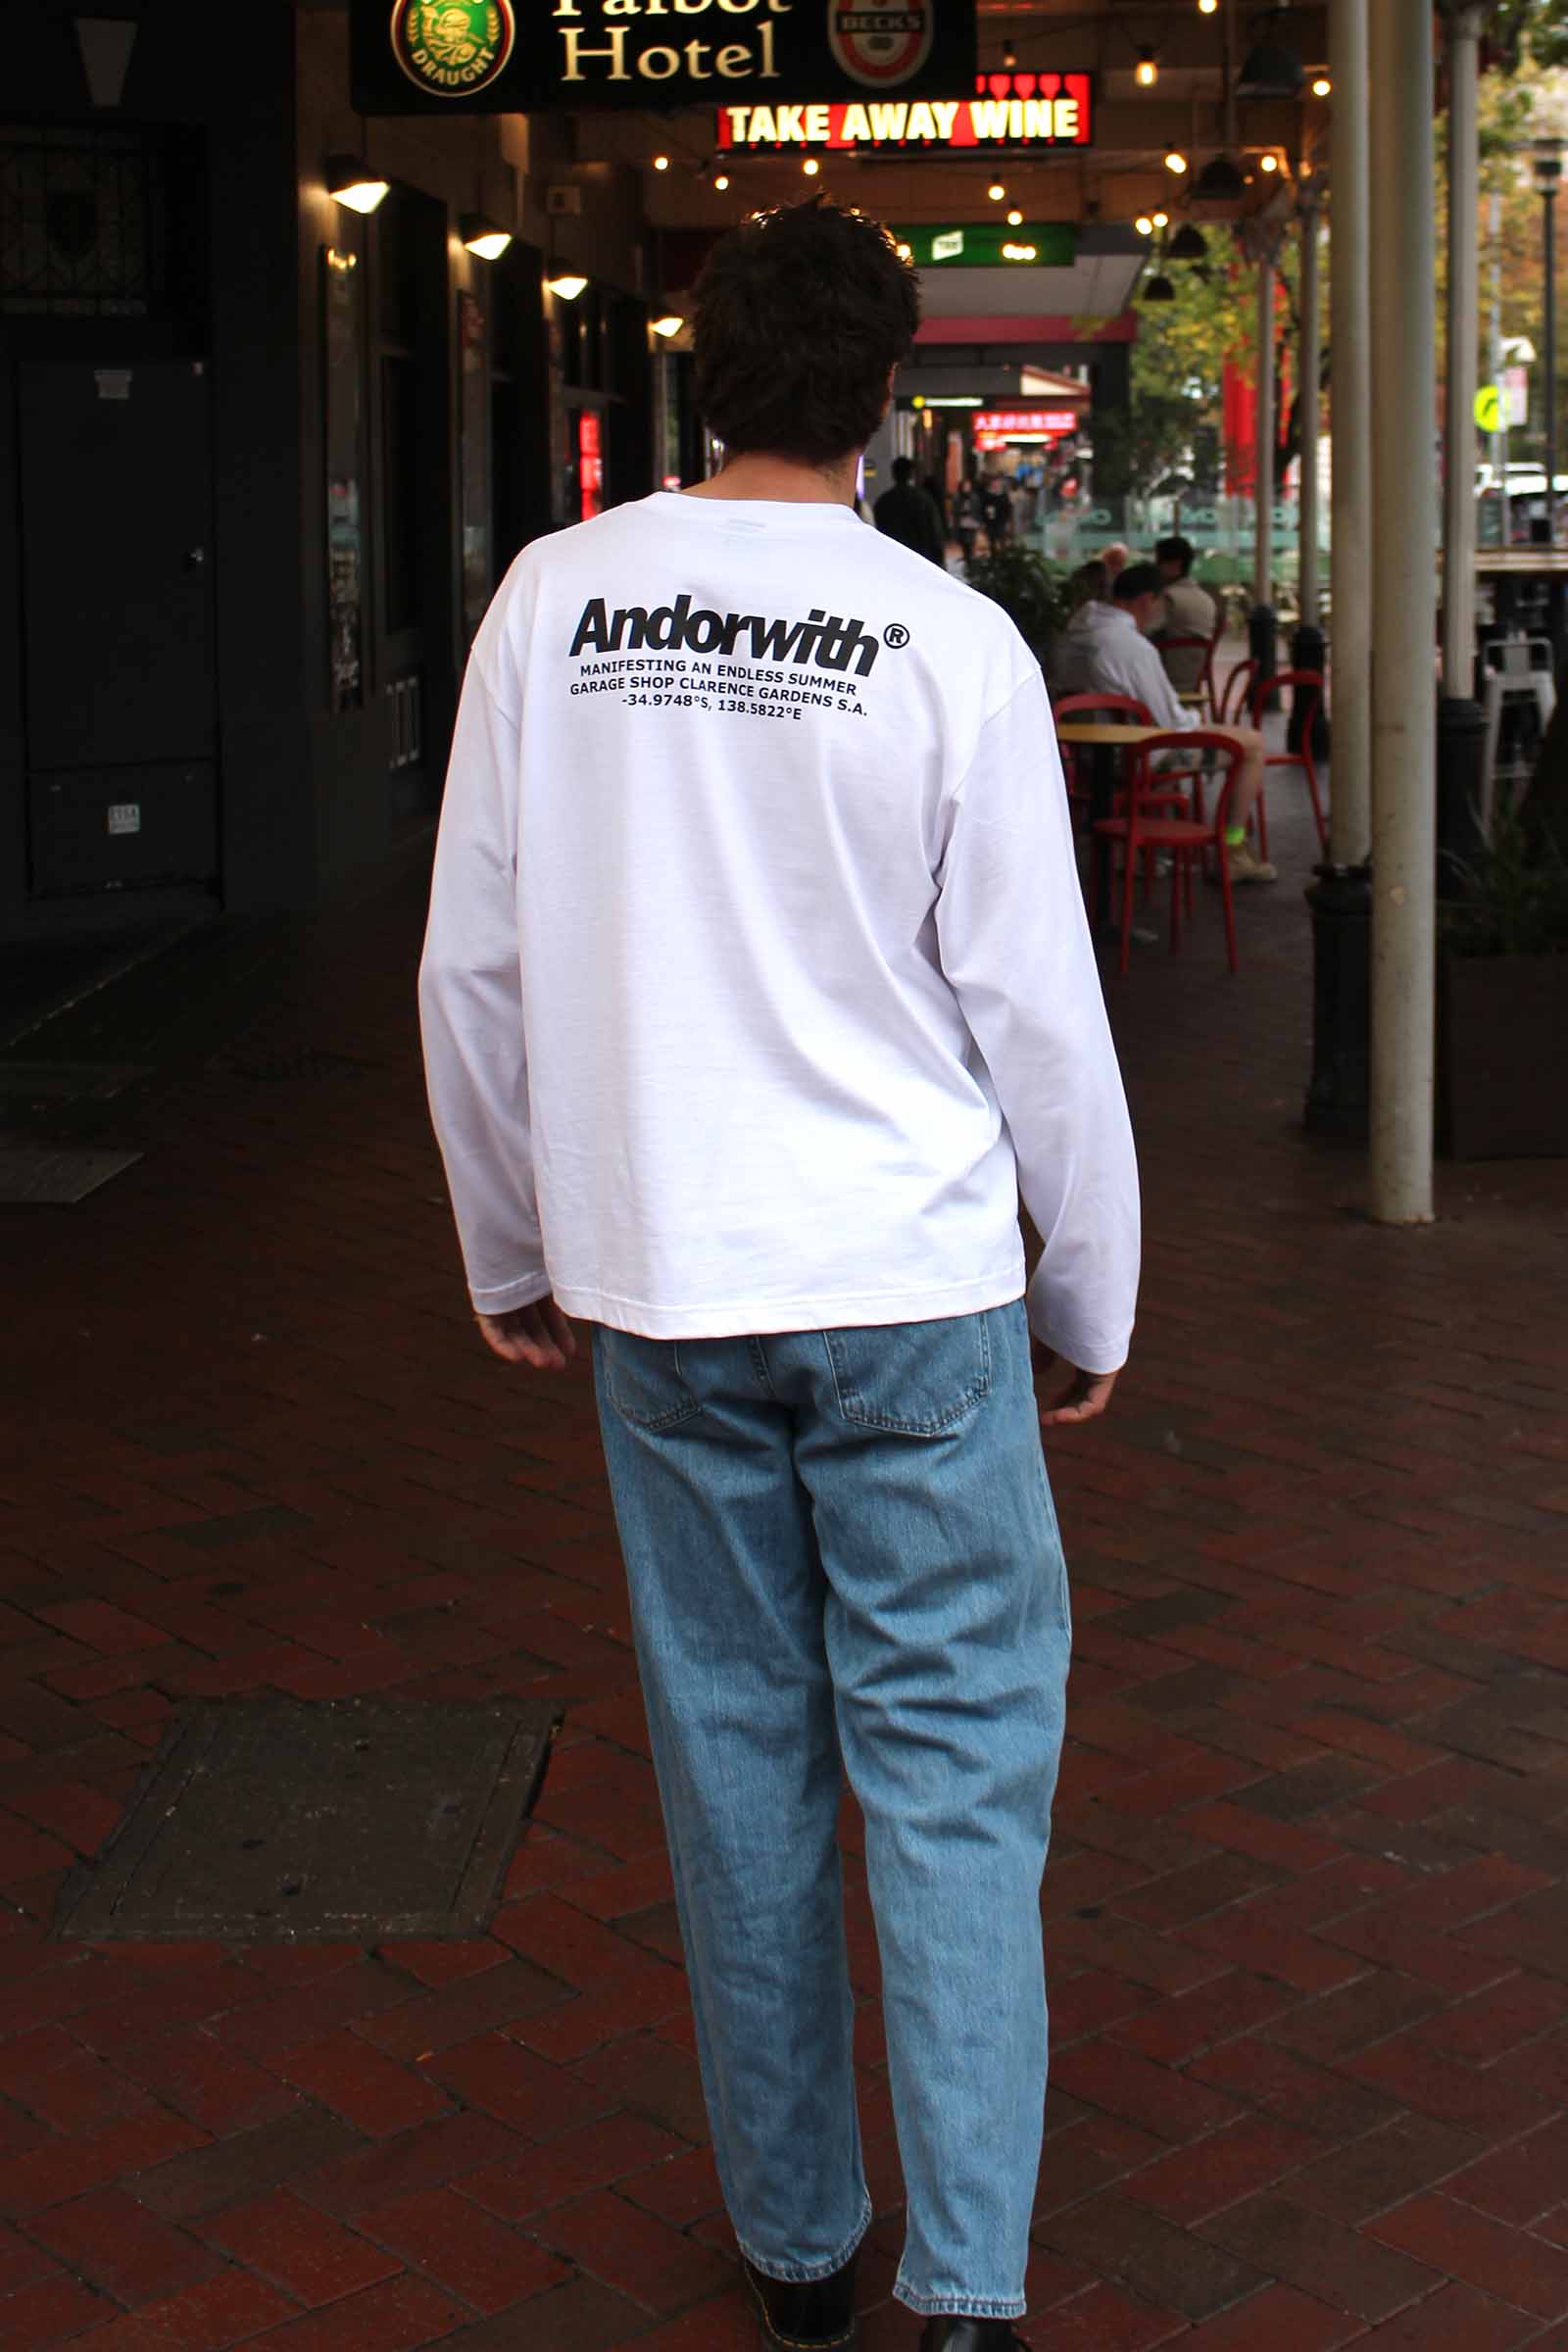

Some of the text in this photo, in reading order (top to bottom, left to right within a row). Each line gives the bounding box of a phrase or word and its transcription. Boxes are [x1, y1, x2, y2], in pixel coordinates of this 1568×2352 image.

[411, 47, 495, 85] DRAUGHT
[558, 20, 781, 81] Hotel
[726, 99, 1080, 142] TAKE AWAY WINE
[569, 676, 868, 716] GARAGE SHOP CLARENCE GARDENS S.A.
[580, 659, 857, 696] MANIFESTING AN ENDLESS SUMMER
[717, 699, 803, 720] 138.5822°E
